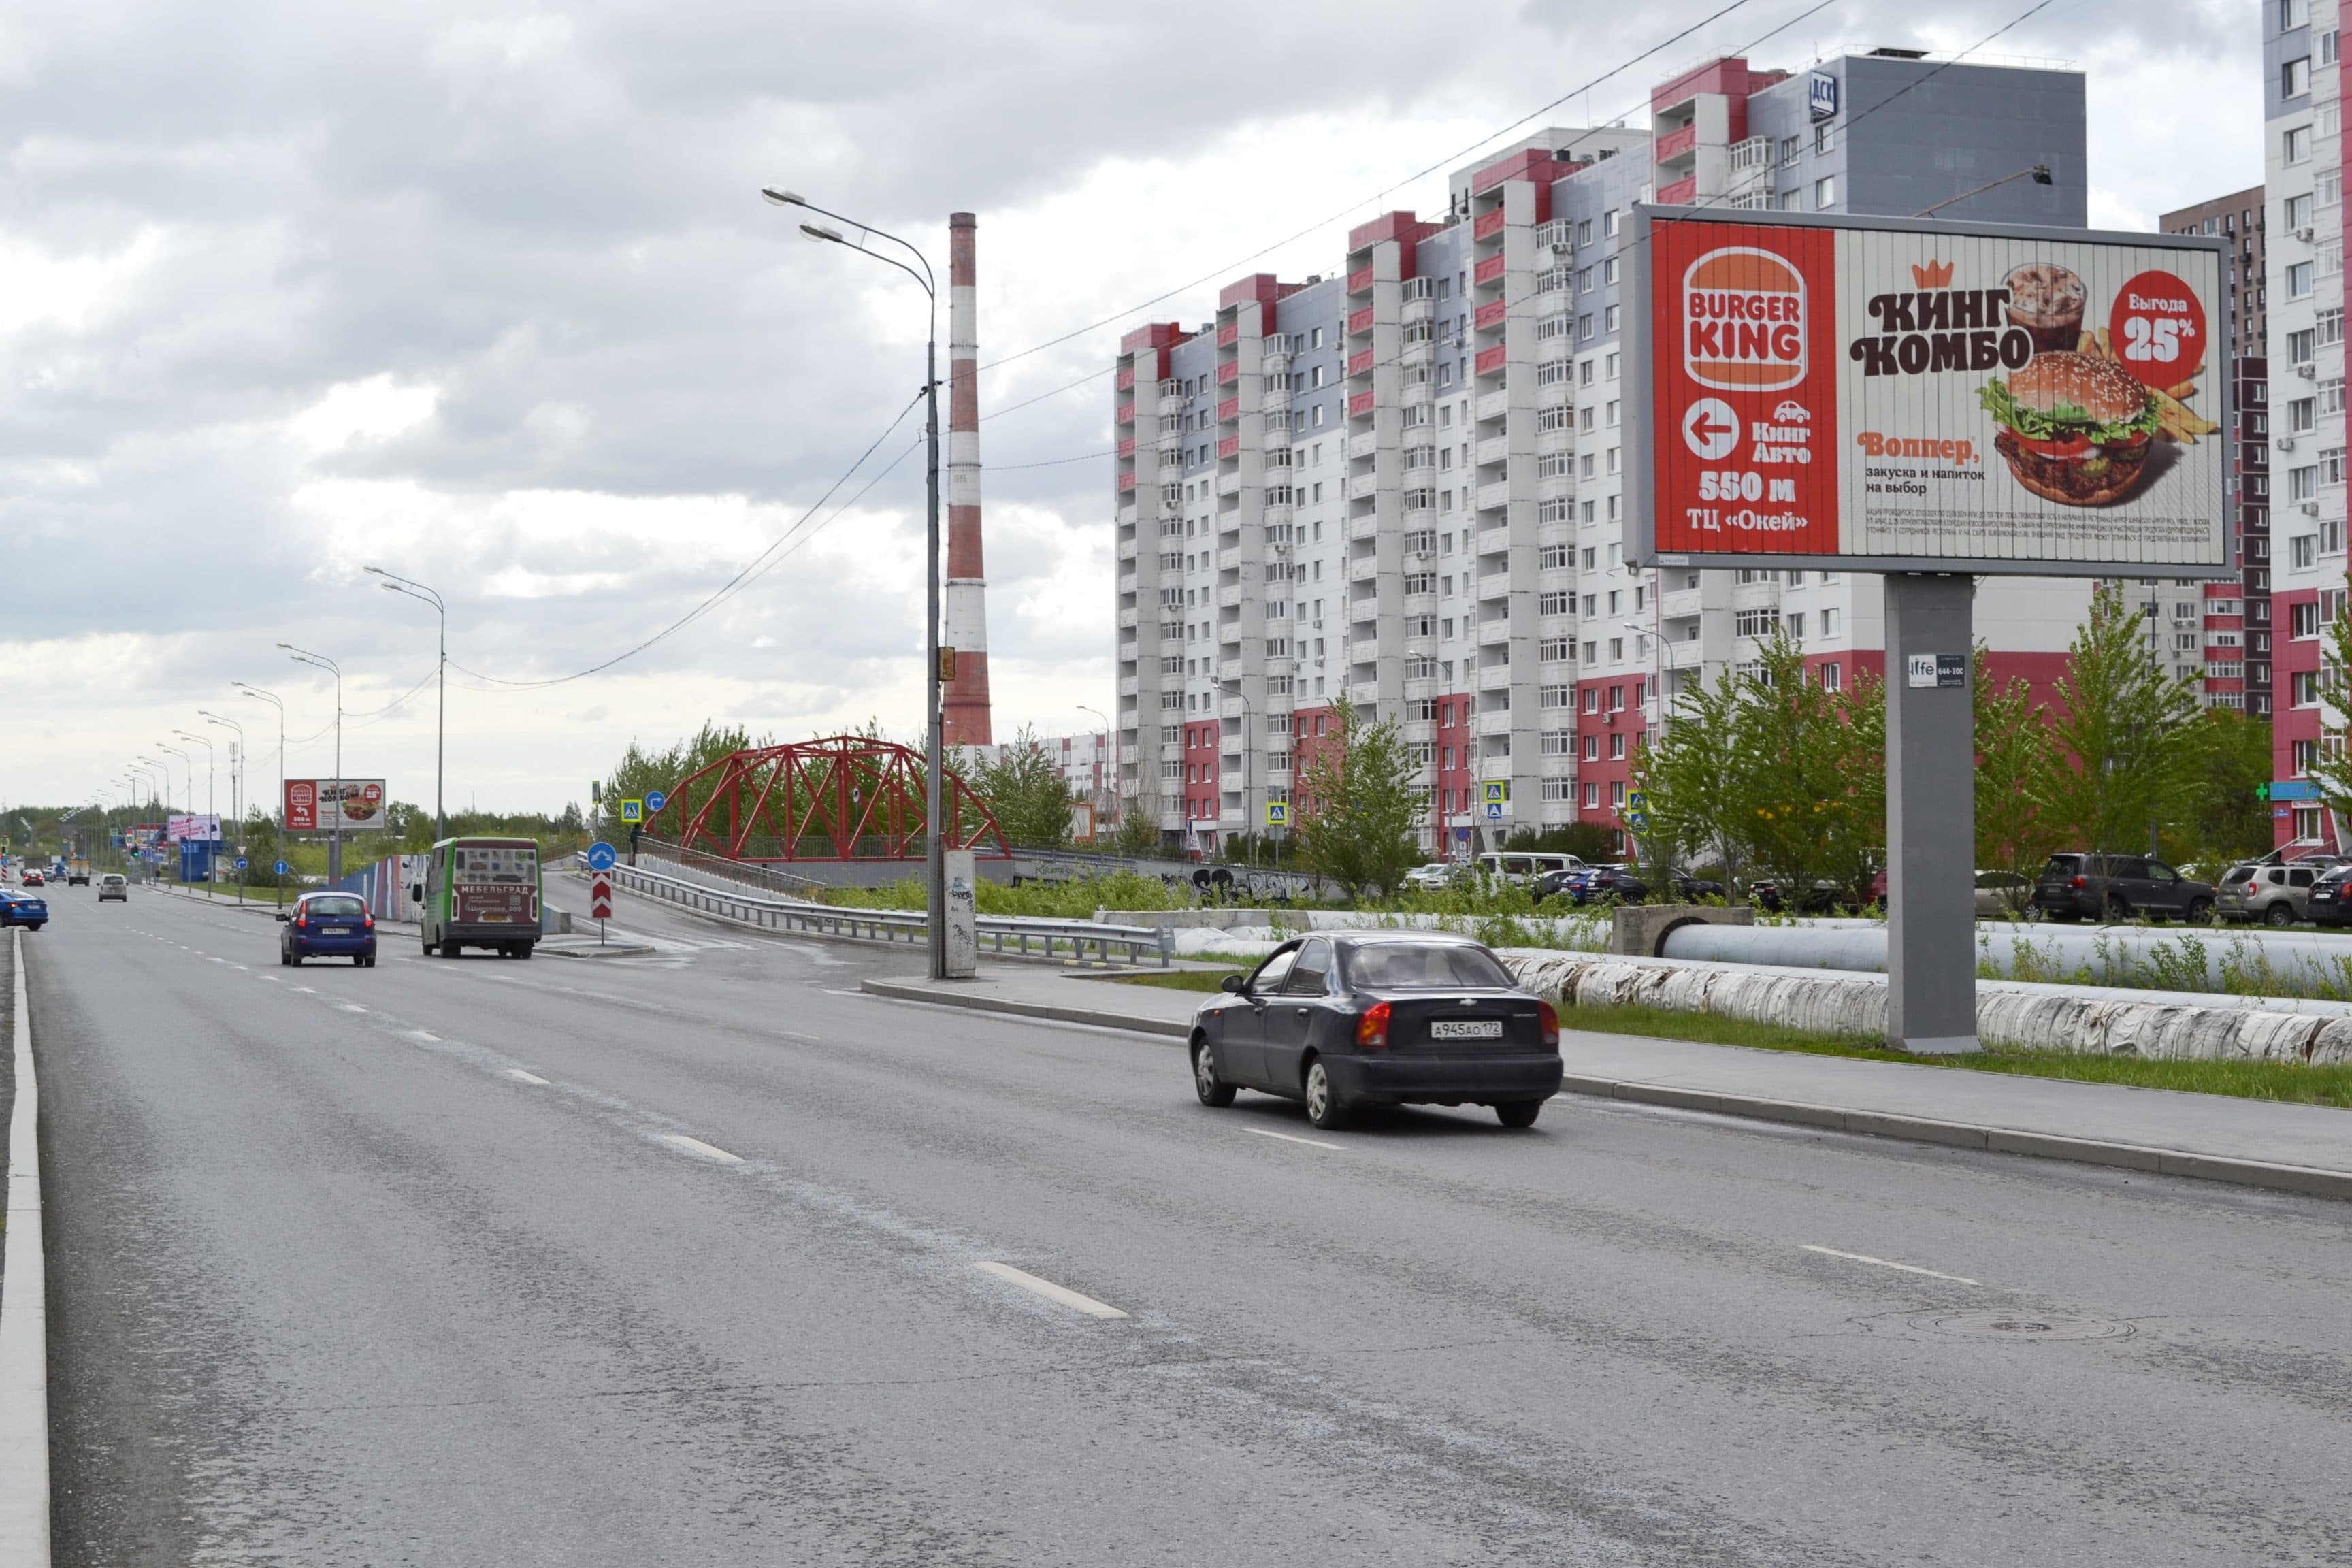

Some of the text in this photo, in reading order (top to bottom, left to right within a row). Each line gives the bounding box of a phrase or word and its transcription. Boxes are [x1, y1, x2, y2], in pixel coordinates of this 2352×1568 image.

[1689, 292, 1801, 323] BURGER
[1868, 289, 2011, 333] КИНГ
[2128, 293, 2189, 314] Выгода
[1689, 320, 1801, 361] KING
[1850, 329, 2031, 376] КОМБО
[1752, 421, 1811, 443] Кинг
[1752, 442, 1812, 464] Авто
[1865, 468, 1986, 480] закуска и напиток
[1699, 471, 1797, 502] 550 м
[1866, 481, 1927, 497] на выбор
[1686, 508, 1808, 533] ТЦ «Окей»
[461, 885, 529, 895] МЕБЕЛЬГРАД
